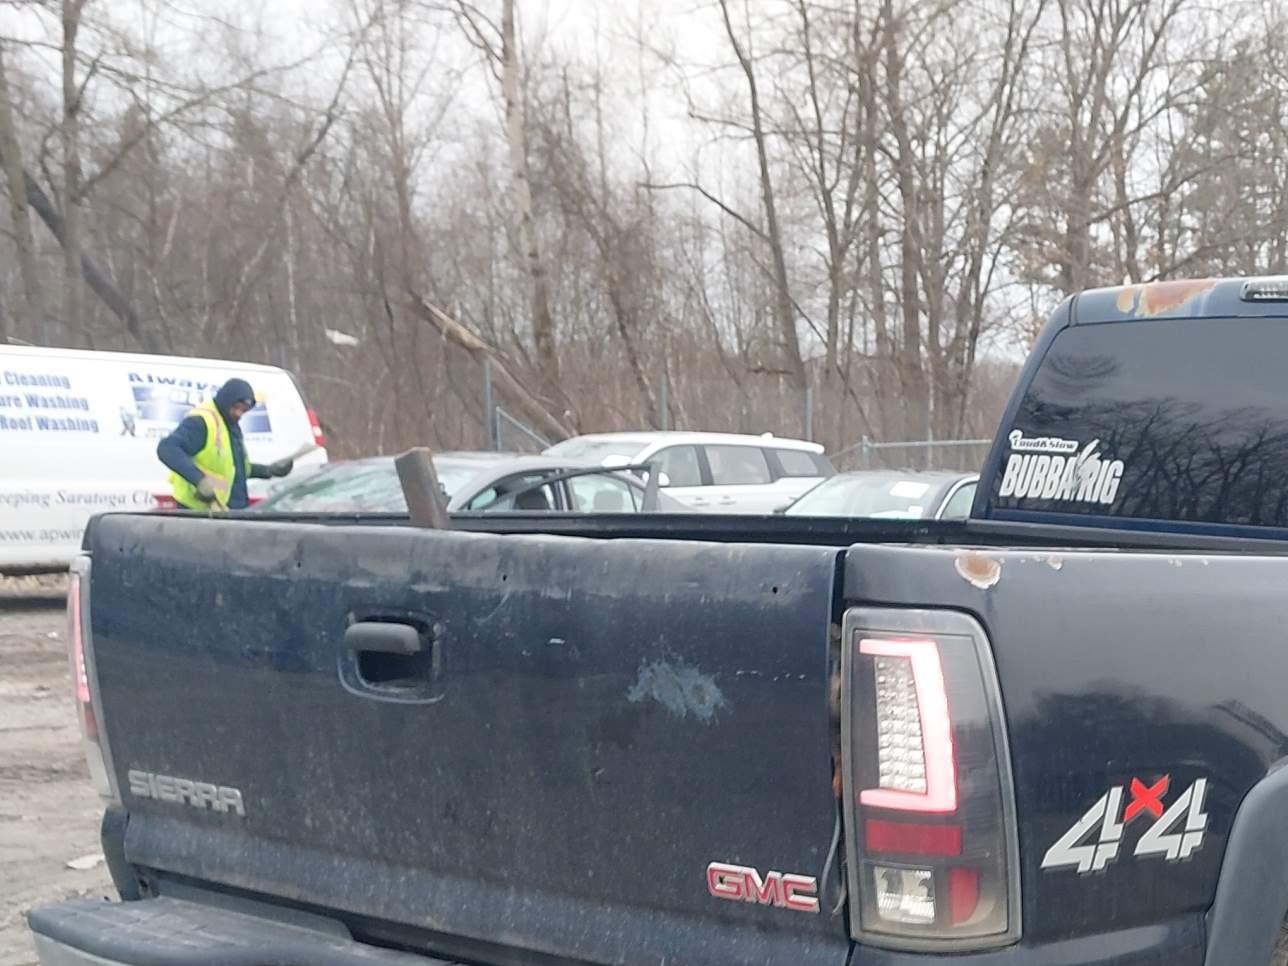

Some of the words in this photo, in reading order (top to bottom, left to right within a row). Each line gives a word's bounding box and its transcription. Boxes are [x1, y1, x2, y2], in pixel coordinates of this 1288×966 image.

[3, 370, 71, 390] Cleaning
[23, 391, 90, 411] Washing
[35, 415, 100, 433] Washing
[55, 489, 127, 507] Saratoga
[128, 769, 246, 816] SIERRA
[706, 861, 820, 914] GMC
